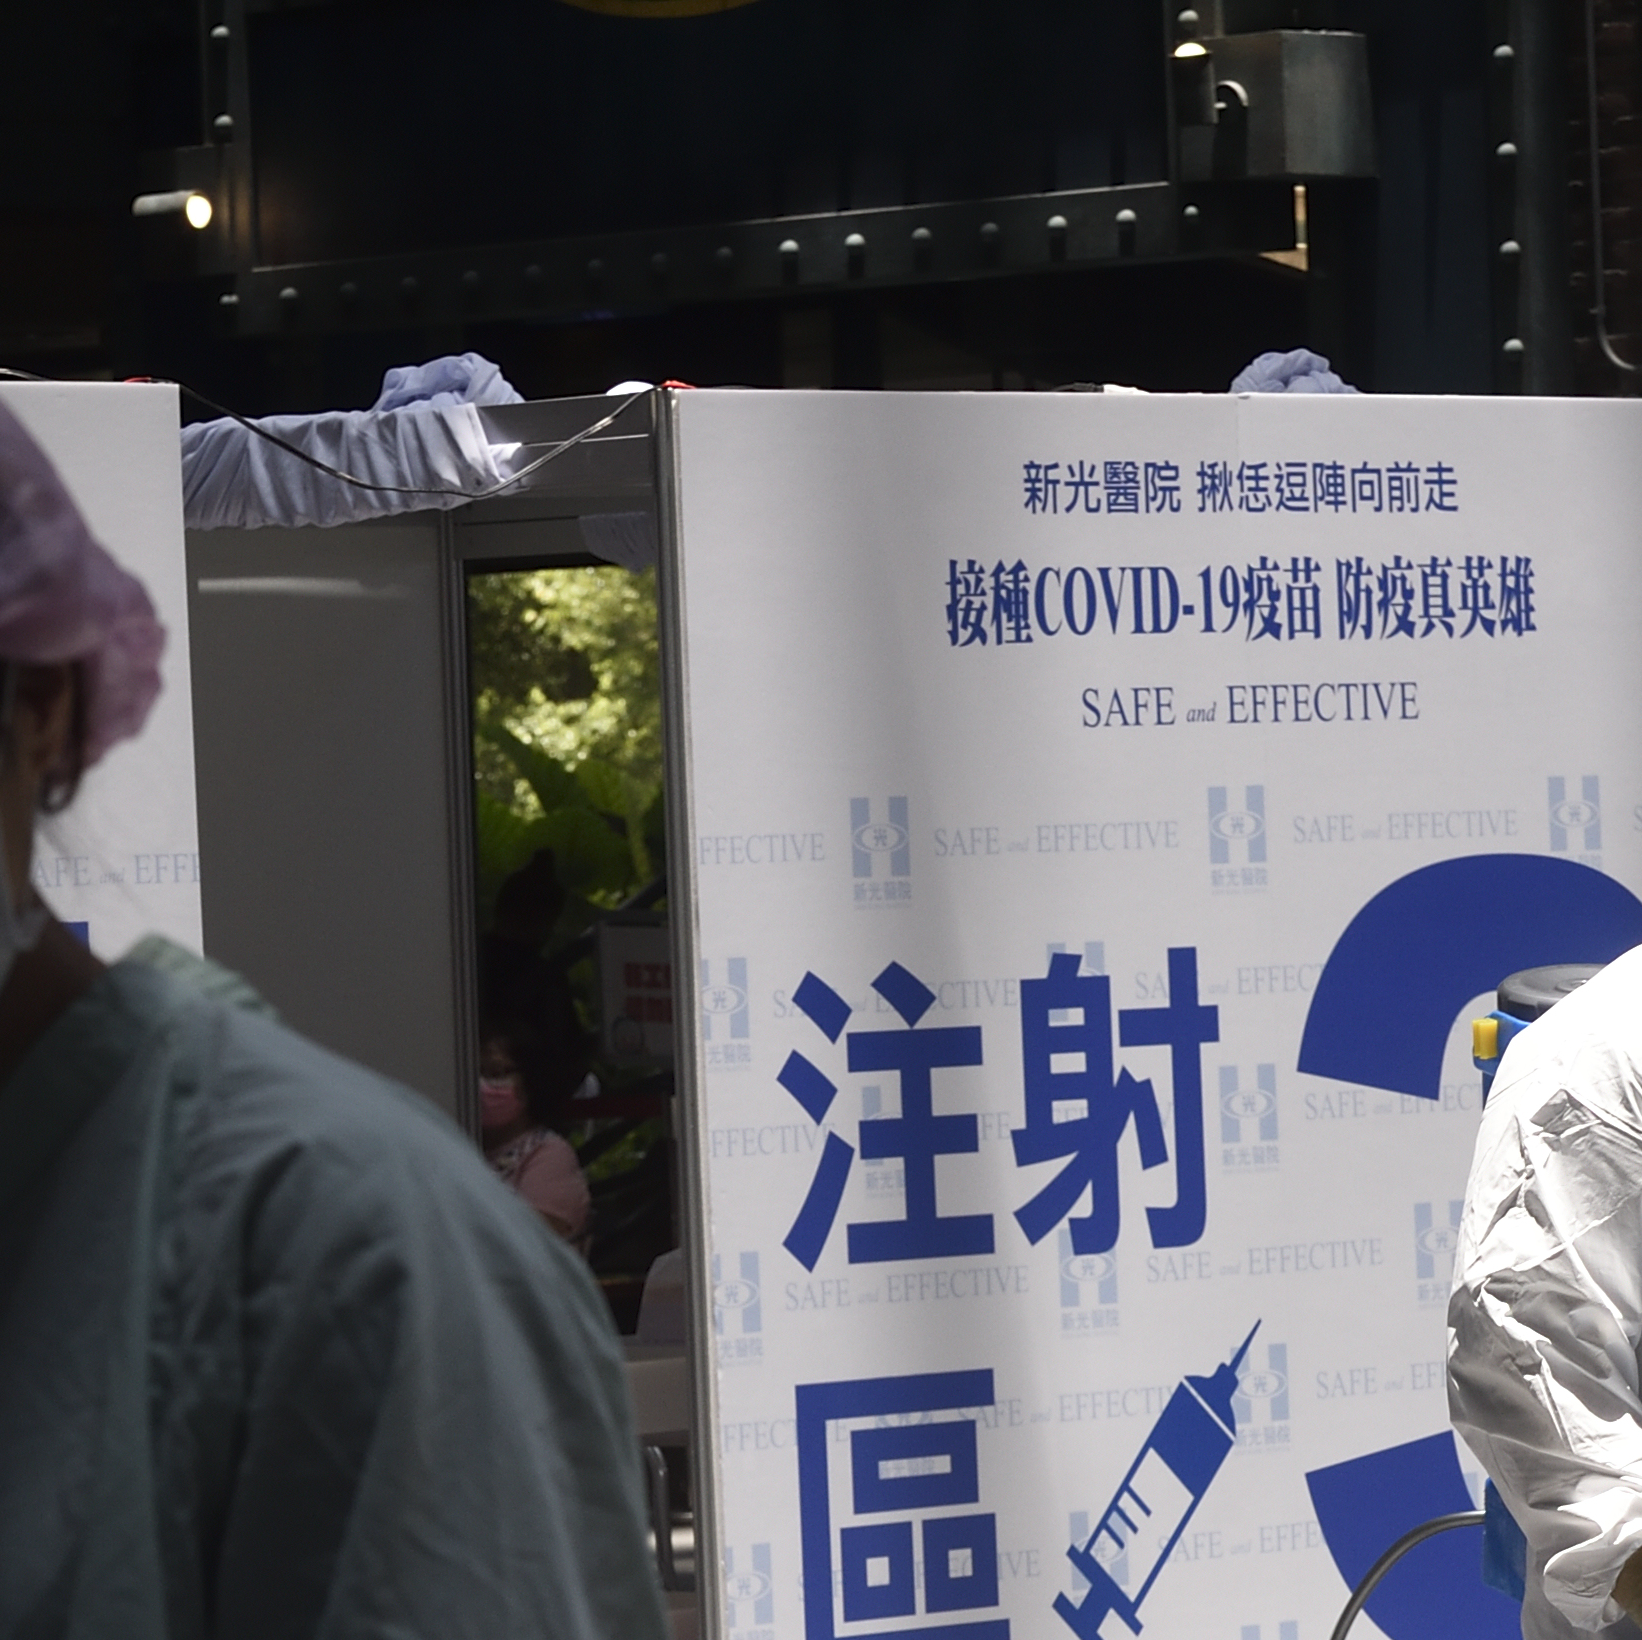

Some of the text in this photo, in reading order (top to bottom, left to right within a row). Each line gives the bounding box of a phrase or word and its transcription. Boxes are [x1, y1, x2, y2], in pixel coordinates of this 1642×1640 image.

[1023, 460, 1458, 514] 新光醫院 揪恁逗陣向前走
[946, 555, 1537, 647] 接種COVID-19疫苗 防疫真英雄
[1082, 681, 1420, 728] SAFE and EFFECTIVE
[935, 827, 999, 857] SAFE
[1037, 821, 1179, 854] EFFECTIVE
[1294, 815, 1354, 843] SAFE
[1388, 809, 1518, 841] EFFECTIVE
[699, 833, 825, 865] FFECTIVE
[35, 856, 91, 887] AFE
[100, 868, 125, 884] and
[777, 946, 1220, 1272] 注射
[1305, 1091, 1367, 1120] SAFE
[1147, 1252, 1212, 1283] SAFE
[1248, 1238, 1384, 1276] EFFECTIVE
[785, 1280, 851, 1311] SAFE
[887, 1266, 1029, 1302] EFFECTIVE
[1316, 1368, 1377, 1399] SAFE
[1060, 1385, 1174, 1422] EFFECTI
